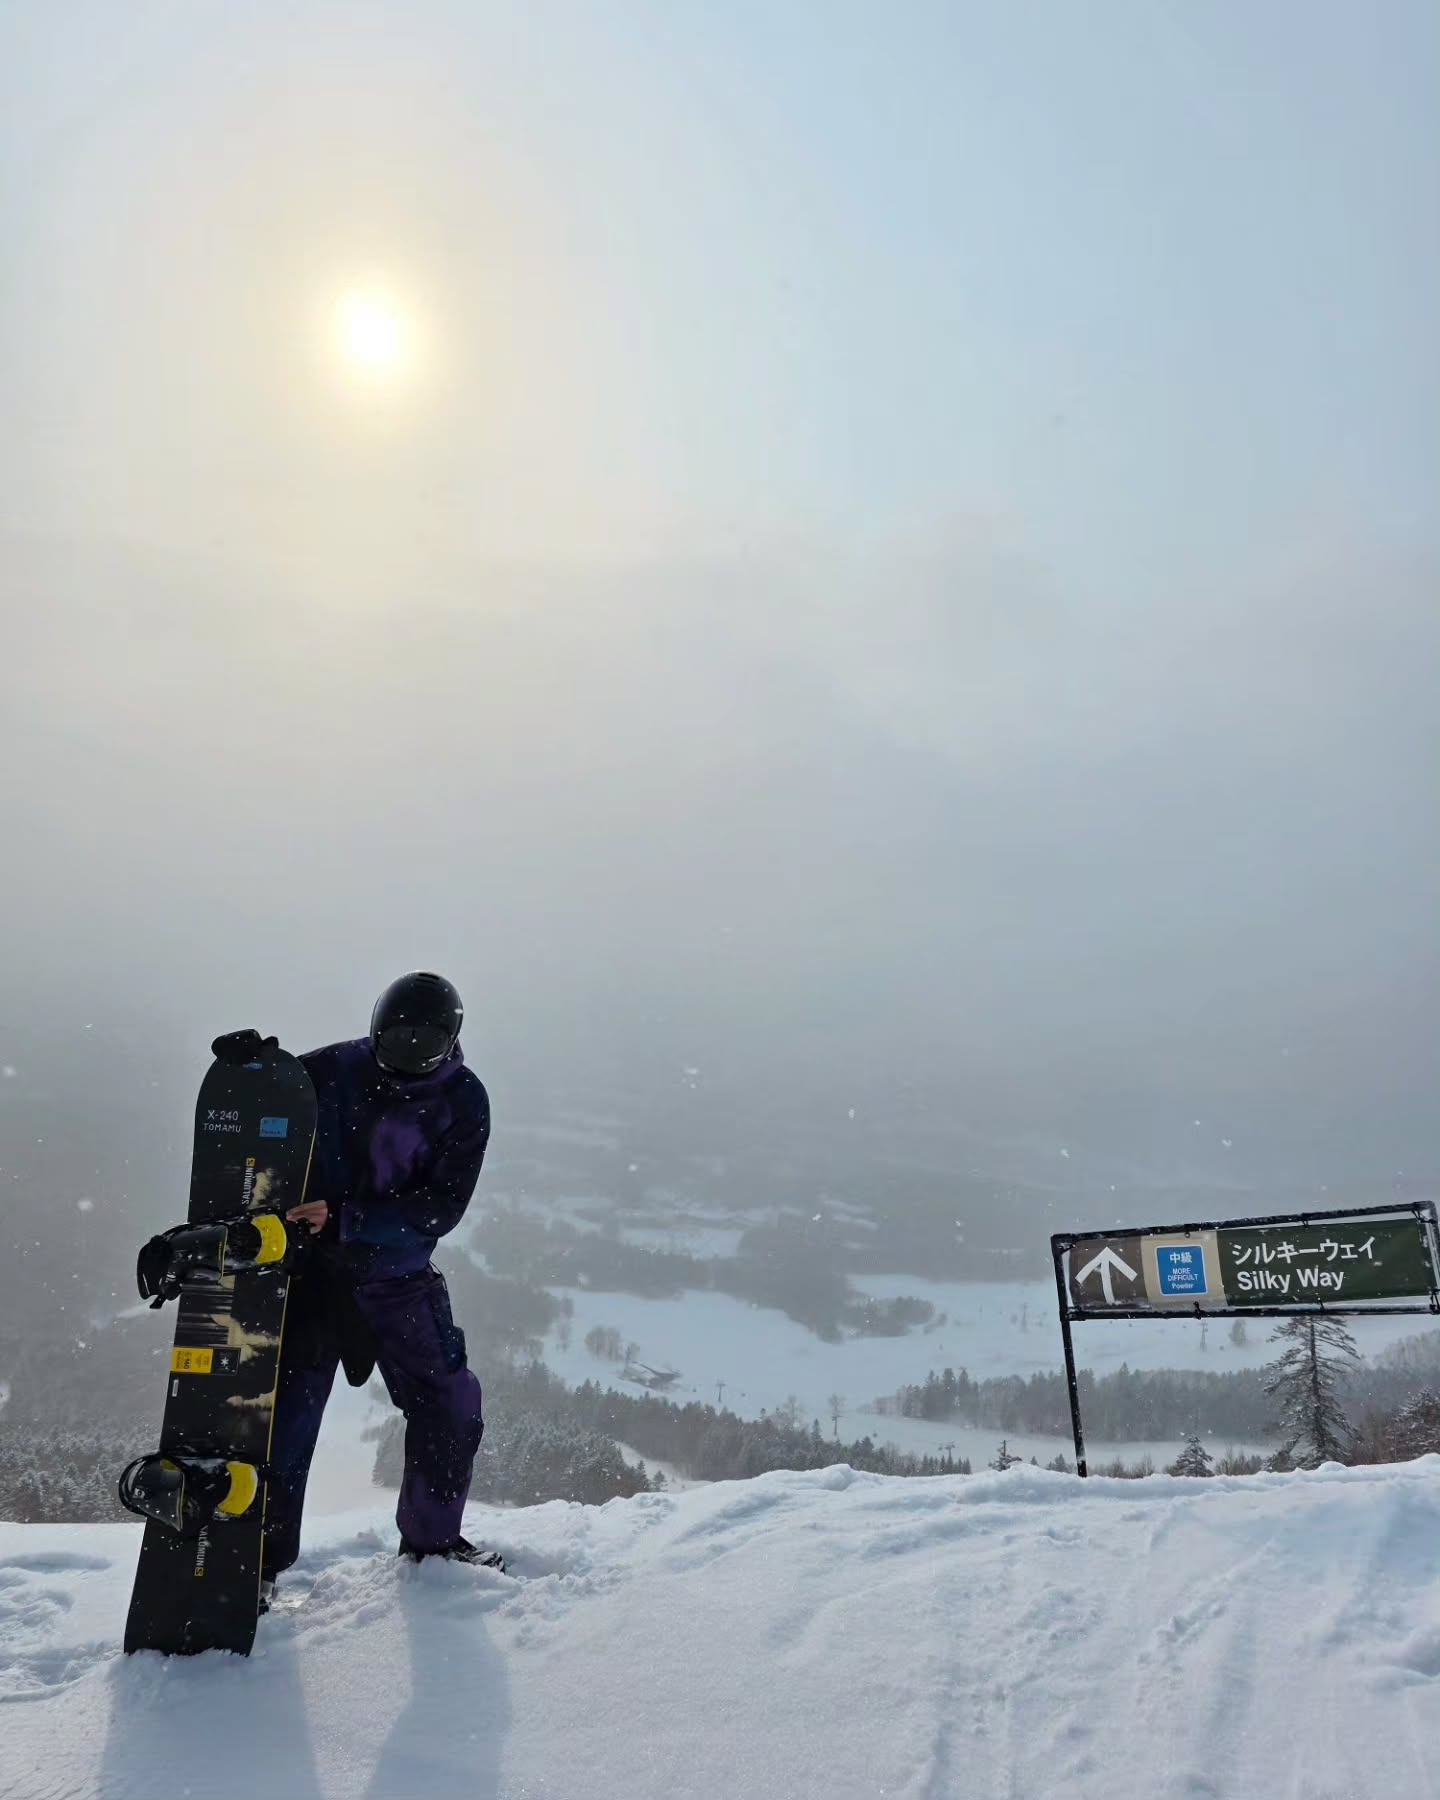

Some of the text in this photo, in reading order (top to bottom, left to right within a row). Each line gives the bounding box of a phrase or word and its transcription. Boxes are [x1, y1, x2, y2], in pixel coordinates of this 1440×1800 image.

[207, 1109, 239, 1121] X-240
[203, 1123, 242, 1134] TOMAMU
[1231, 1236, 1376, 1265] シルキーウェイ
[1169, 1251, 1193, 1264] 中級
[1172, 1267, 1191, 1275] MORE
[1167, 1274, 1199, 1282] DIFFICULT
[1237, 1267, 1345, 1293] Silky Way
